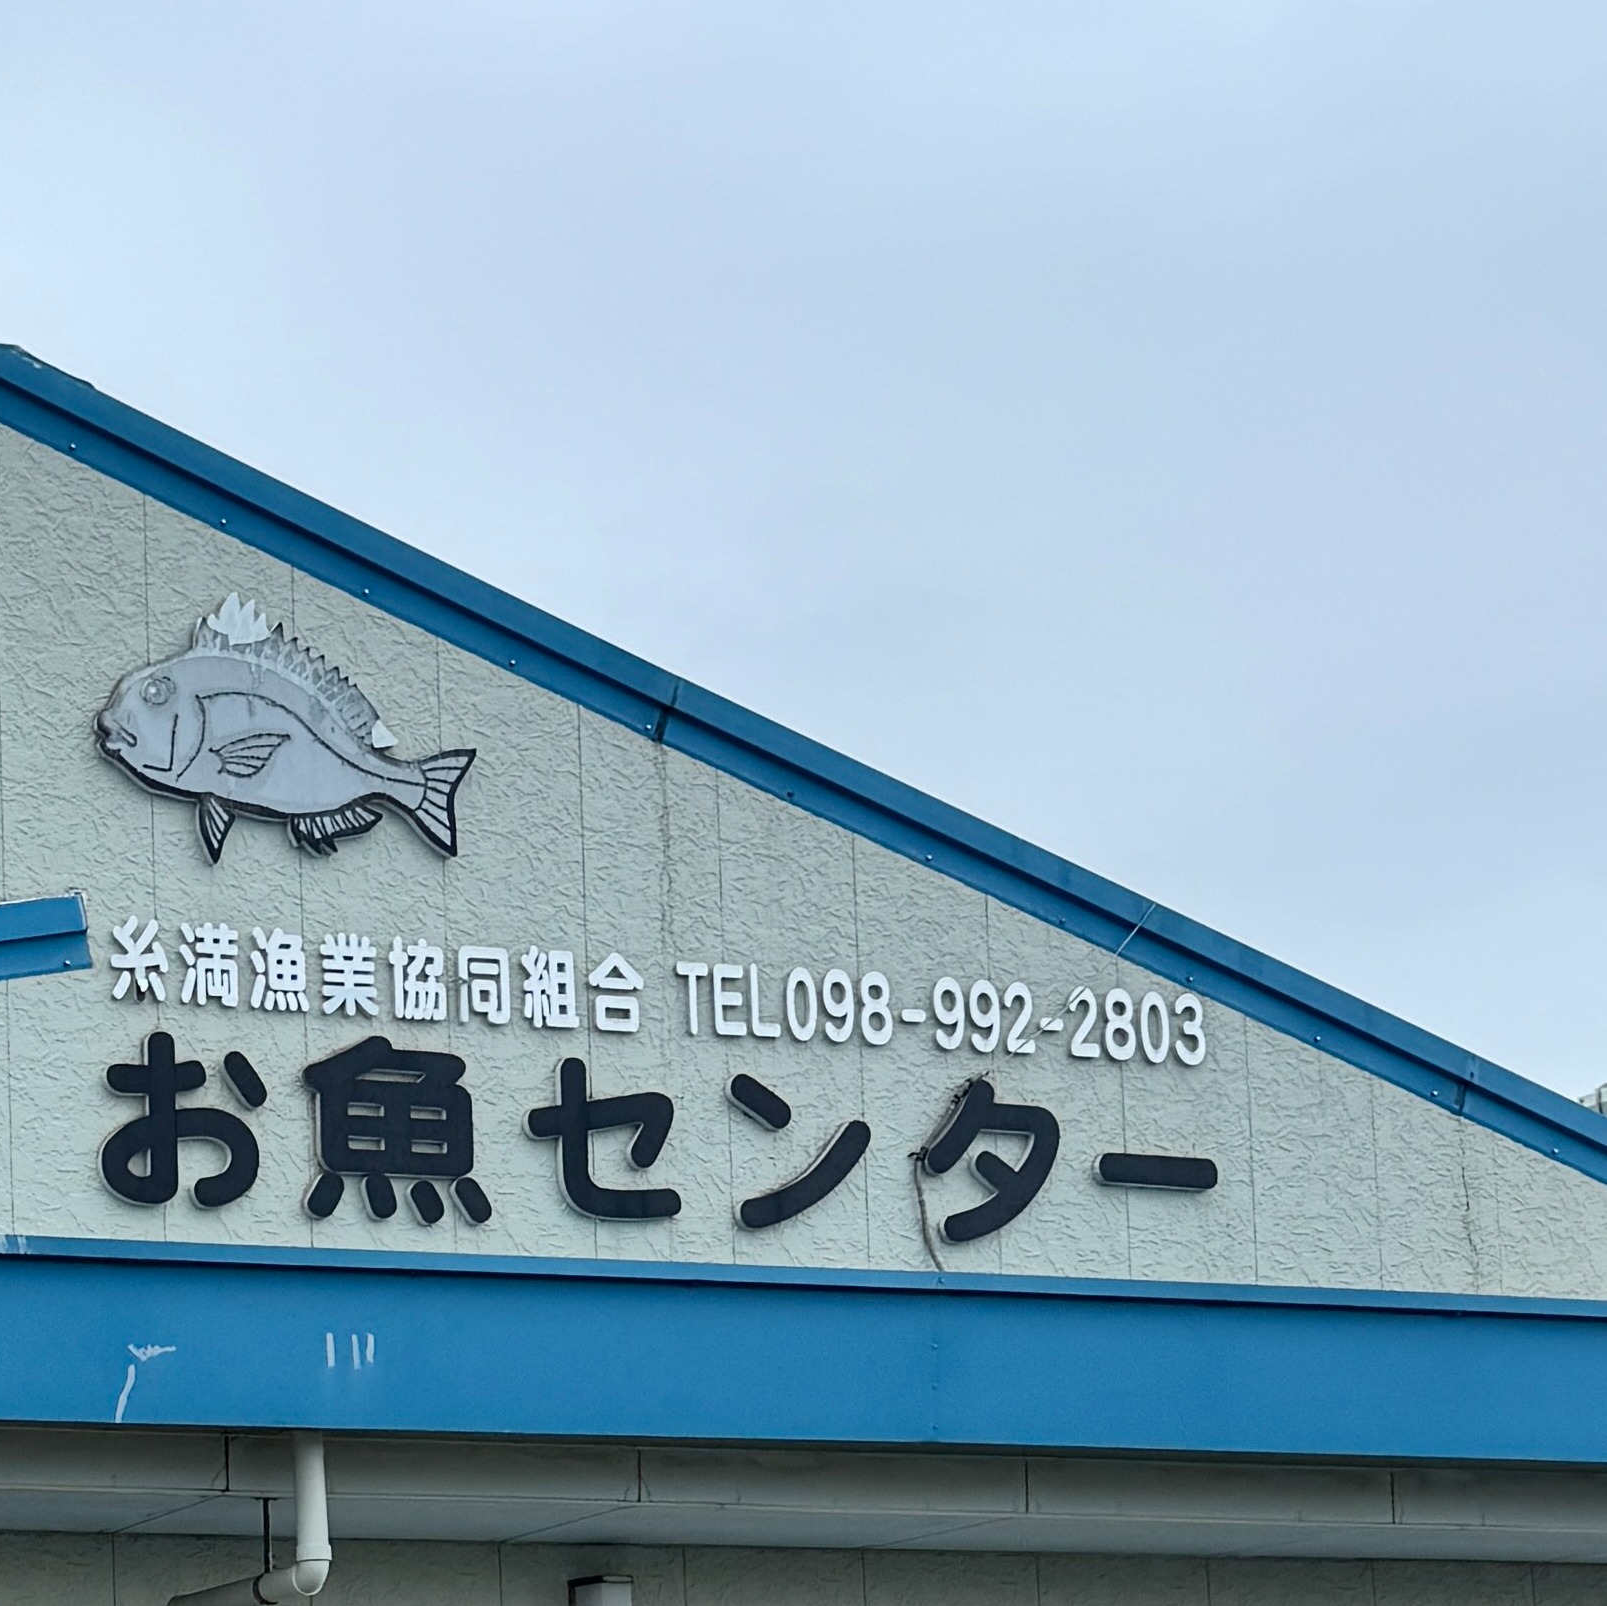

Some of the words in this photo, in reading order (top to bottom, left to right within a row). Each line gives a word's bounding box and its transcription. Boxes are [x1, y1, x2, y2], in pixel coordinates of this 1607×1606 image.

[110, 915, 644, 1032] 糸満漁業協同組合
[100, 1030, 1219, 1243] お魚センター
